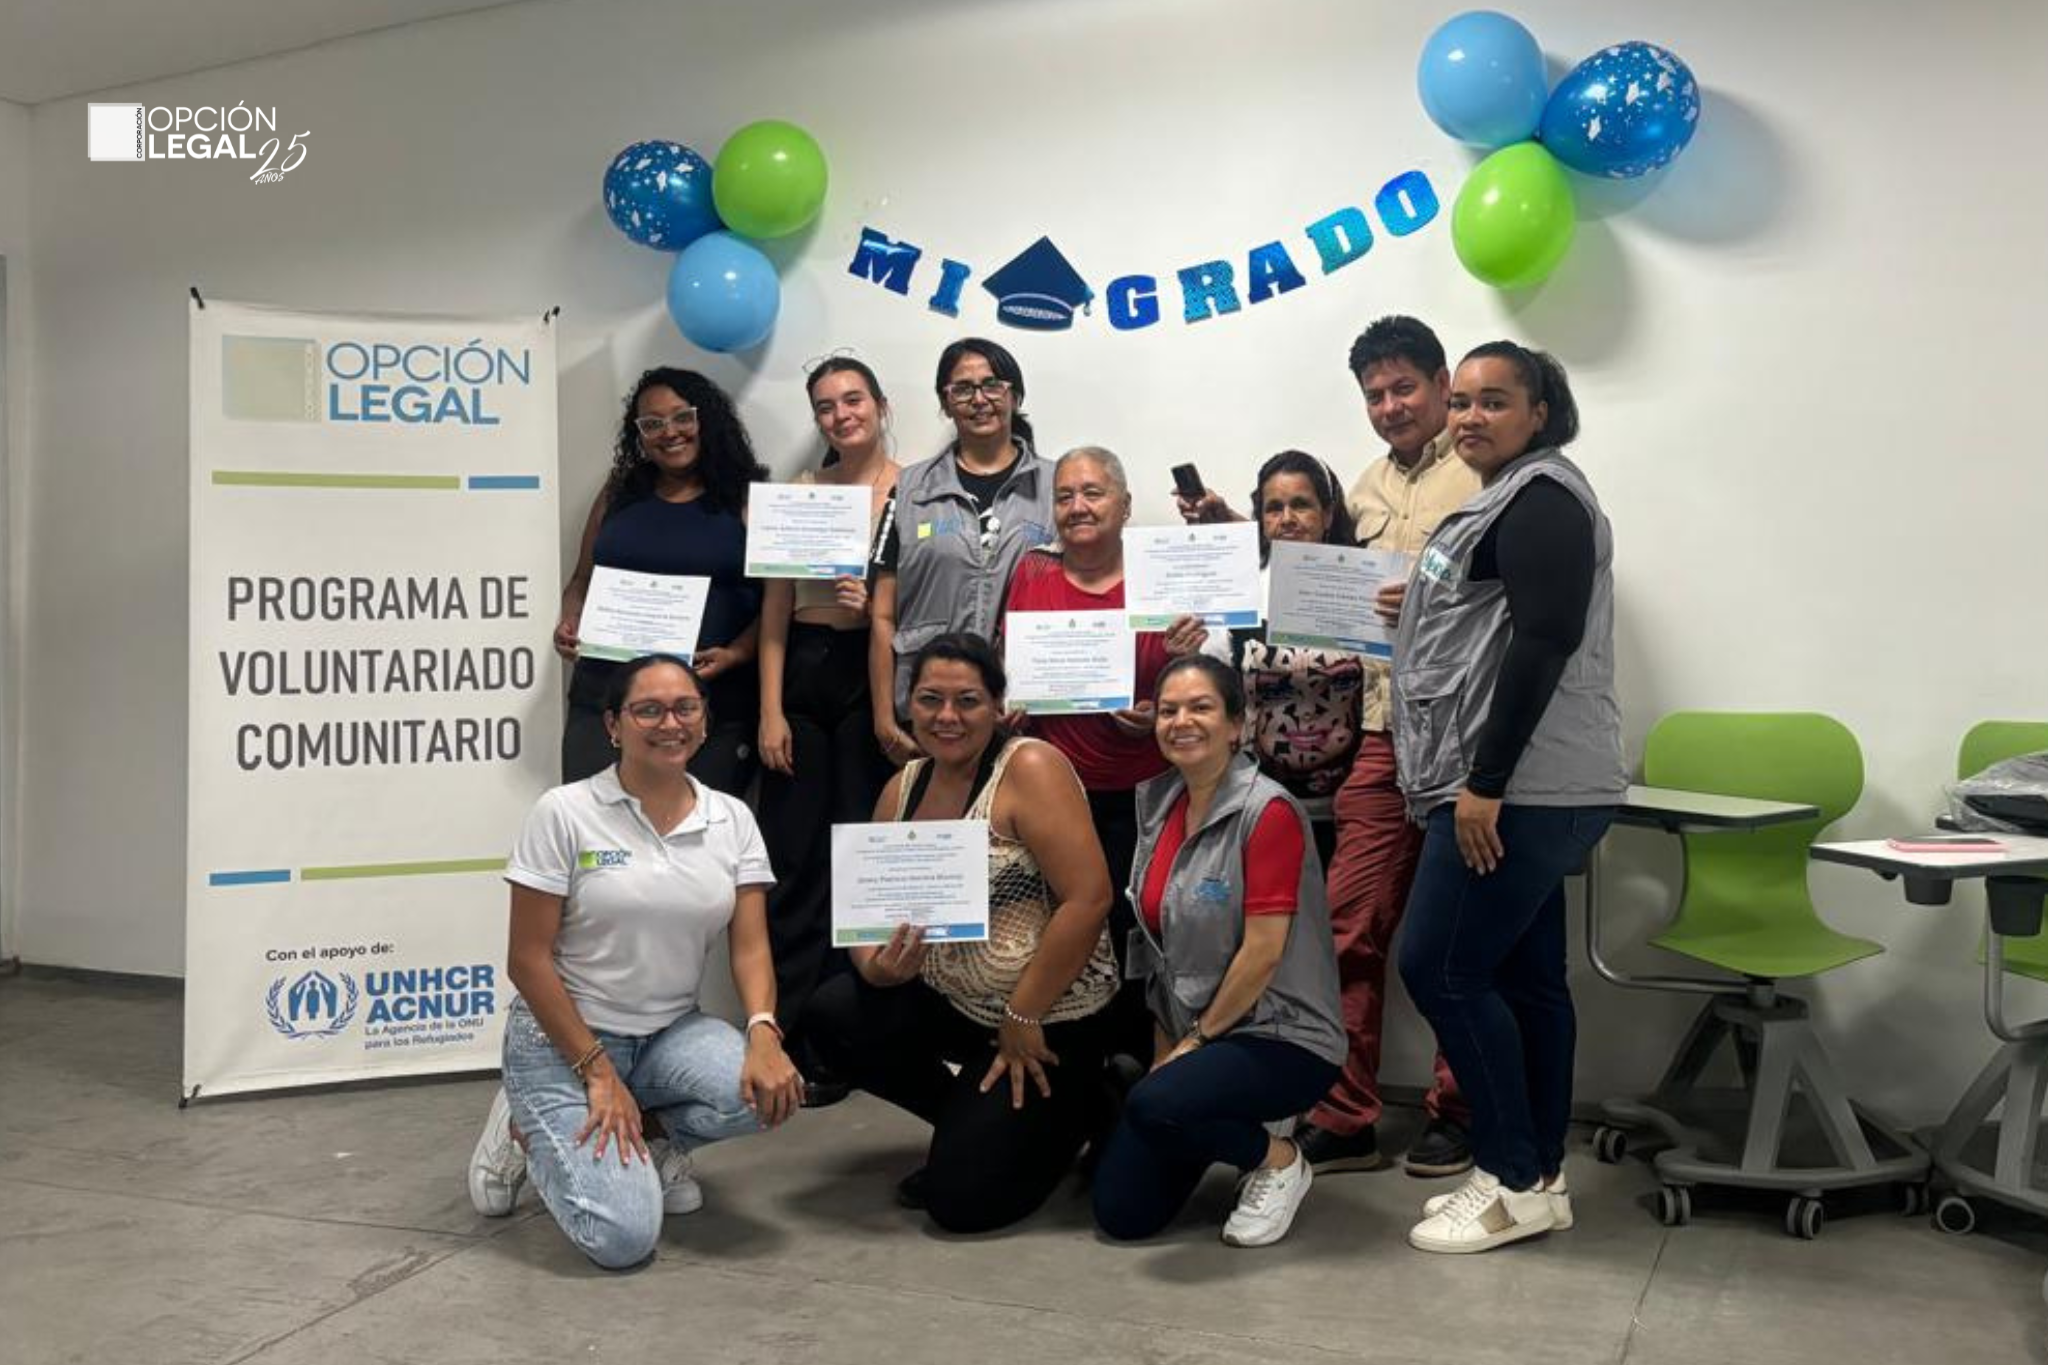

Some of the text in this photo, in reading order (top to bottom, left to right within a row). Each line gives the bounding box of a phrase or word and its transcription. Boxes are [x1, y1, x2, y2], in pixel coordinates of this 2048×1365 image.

[848, 170, 1441, 331] MI GRADO
[326, 338, 530, 385] OPCIÓN
[329, 383, 500, 425] LEGAL
[227, 576, 529, 621] PROGRAMA DE
[219, 646, 534, 696] VOLUNTARIADO
[236, 716, 521, 771] COMUNITARIO
[265, 942, 394, 962] Con el apoyo de:
[365, 964, 495, 997] UNHCR
[365, 991, 495, 1024] ACNUR
[365, 1025, 379, 1036] La
[381, 1023, 427, 1036] Agencia
[429, 1021, 443, 1030] de
[365, 1032, 475, 1050] para los Refugiados
